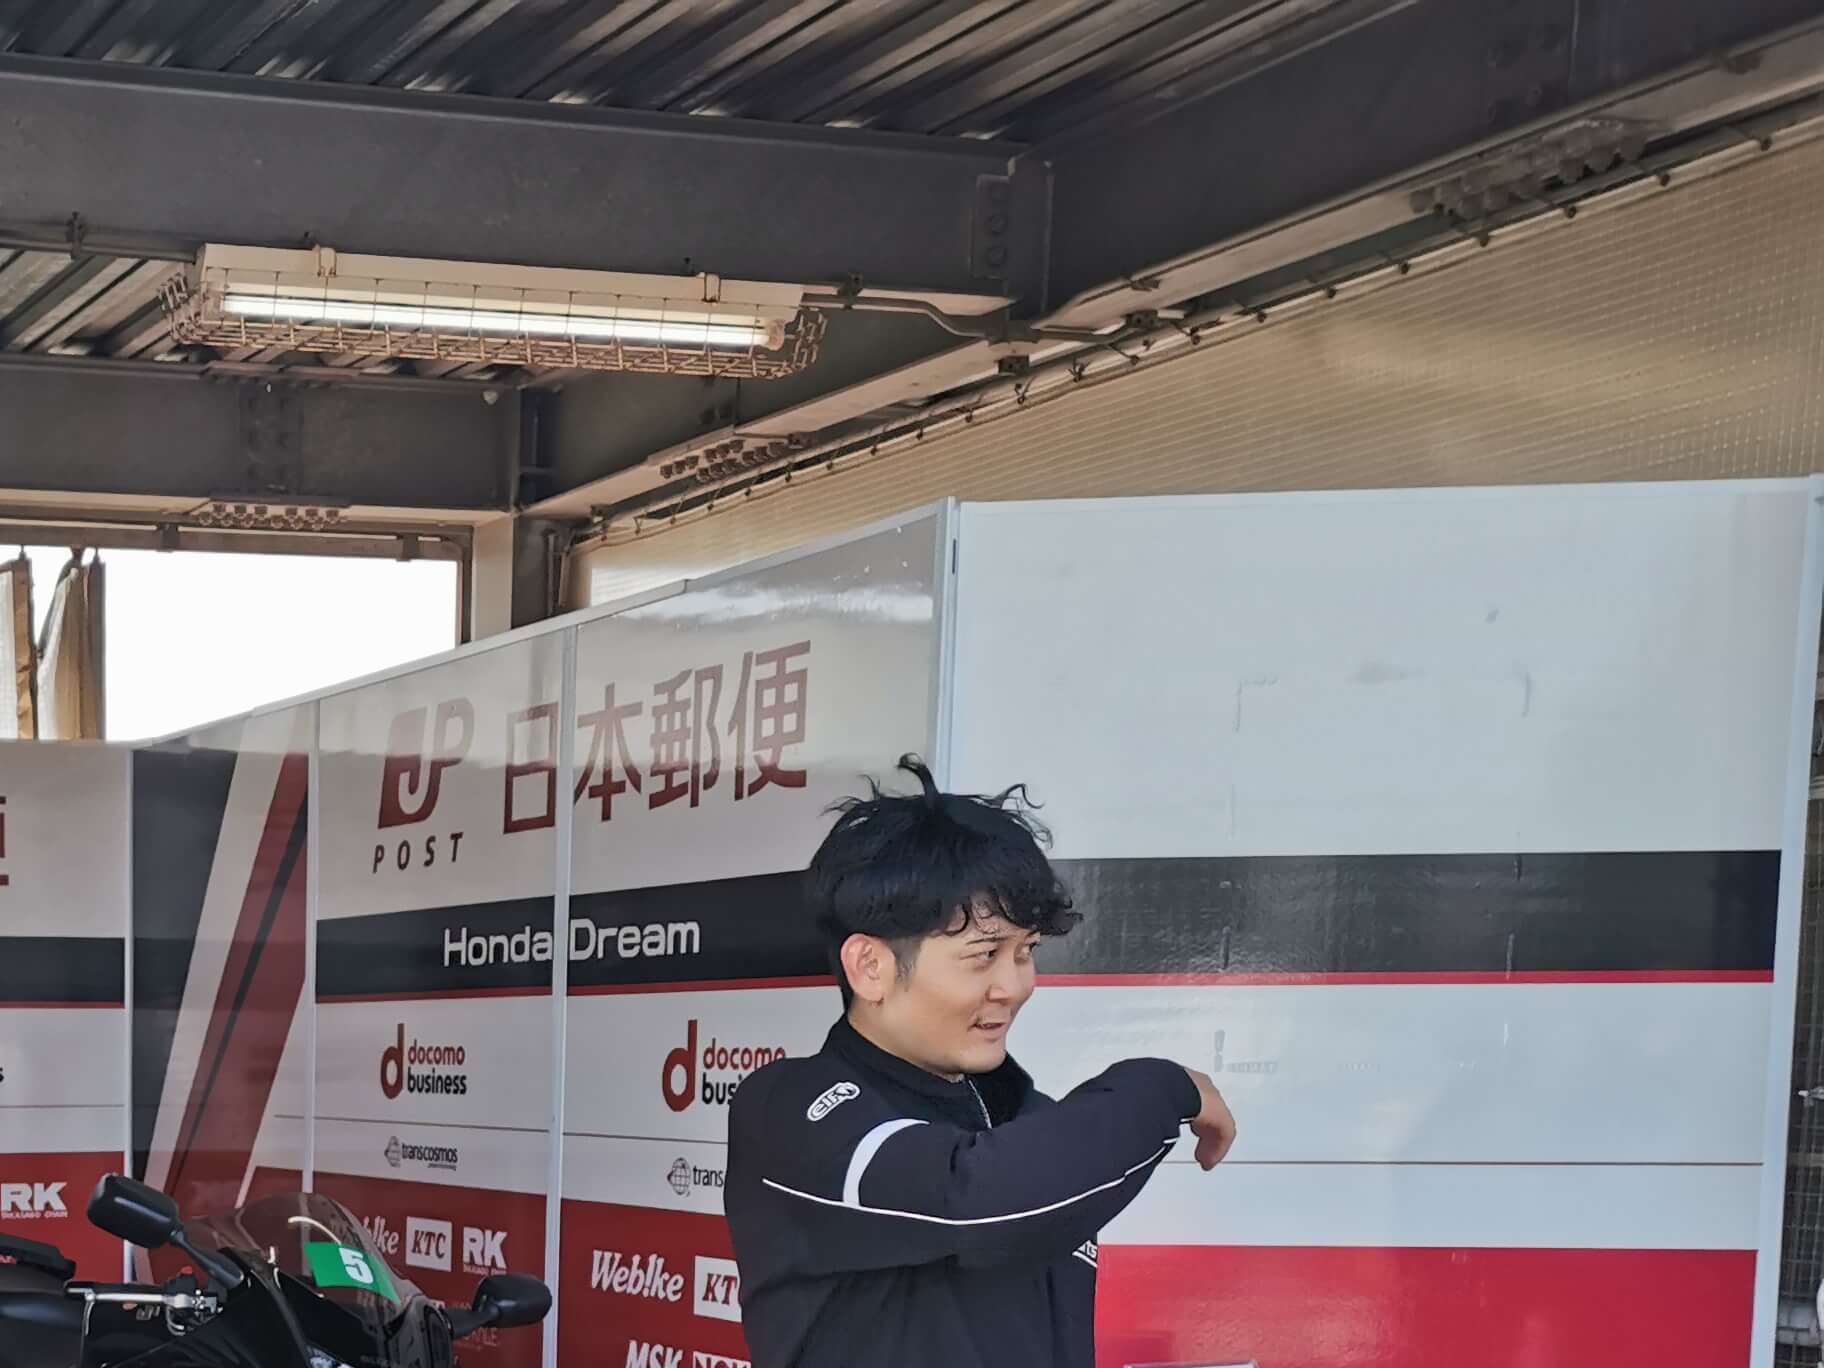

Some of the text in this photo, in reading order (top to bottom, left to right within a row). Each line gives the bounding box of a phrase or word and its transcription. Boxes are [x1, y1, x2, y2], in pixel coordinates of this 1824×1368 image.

[503, 641, 811, 834] 日本郵便
[373, 832, 463, 873] POST
[443, 918, 701, 967] Honda Dream
[407, 1038, 466, 1066] docomo
[407, 1068, 467, 1096] business
[1, 1182, 67, 1211] RK
[412, 1230, 446, 1259] KTC
[463, 1227, 508, 1269] RK
[339, 1247, 374, 1284] 5
[703, 1272, 738, 1305] KT
